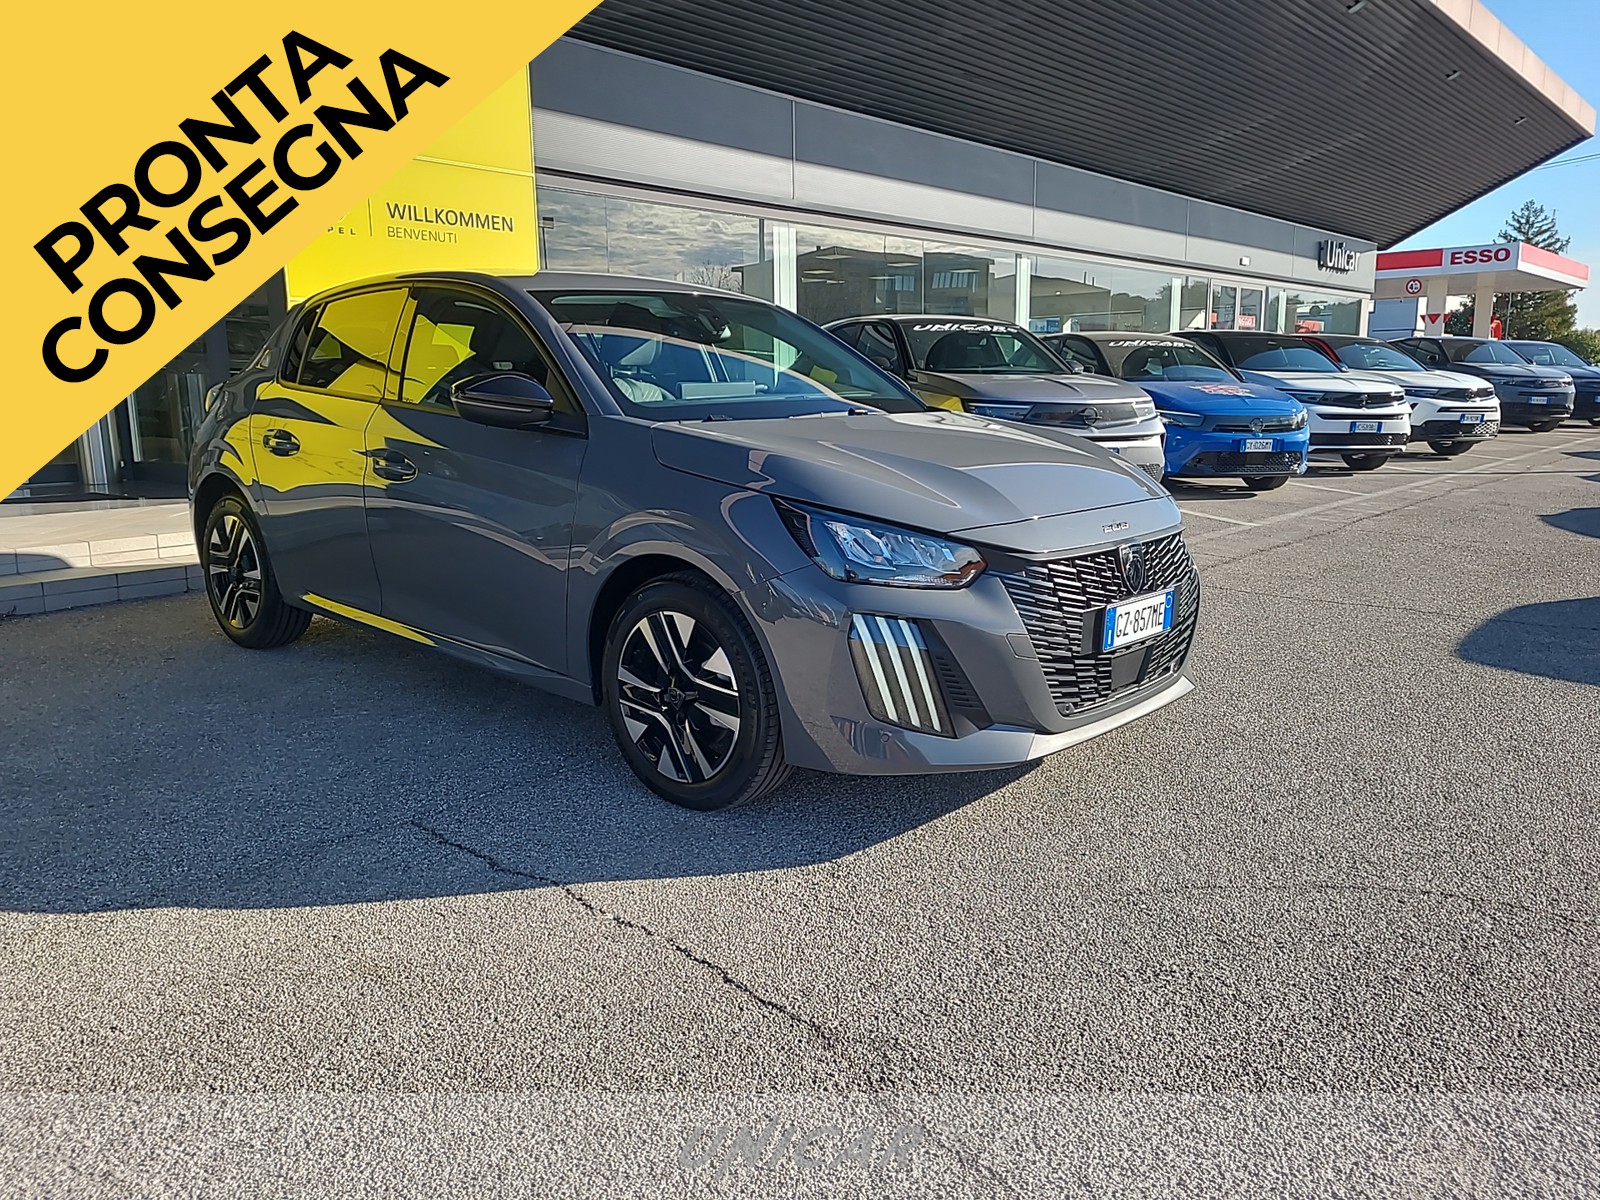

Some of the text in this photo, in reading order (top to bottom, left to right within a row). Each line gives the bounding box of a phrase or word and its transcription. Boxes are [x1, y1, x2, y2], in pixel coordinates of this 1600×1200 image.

[386, 202, 514, 232] WILLKOMMEN
[327, 226, 356, 235] PEL
[387, 226, 458, 243] BENVENUTI
[1327, 239, 1360, 272] Unicar
[1450, 248, 1511, 265] ESSO
[913, 323, 1007, 333] UNICAR
